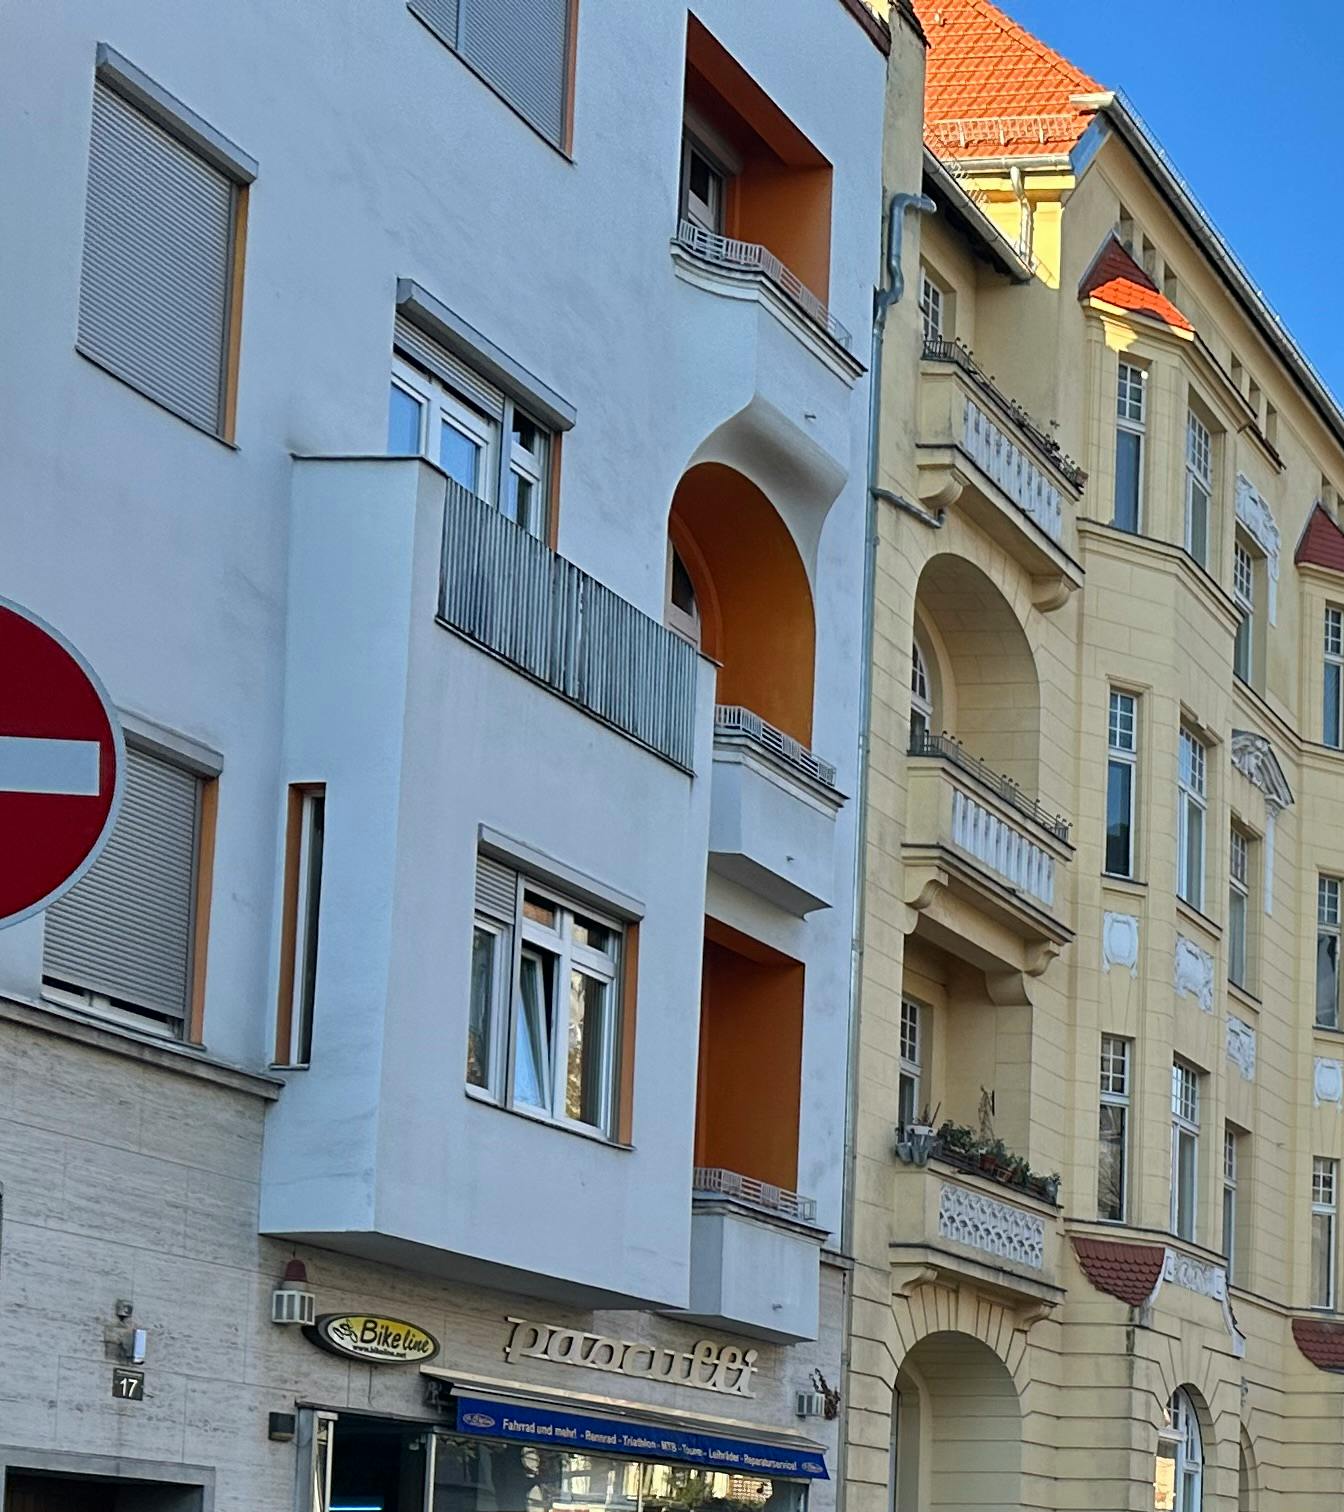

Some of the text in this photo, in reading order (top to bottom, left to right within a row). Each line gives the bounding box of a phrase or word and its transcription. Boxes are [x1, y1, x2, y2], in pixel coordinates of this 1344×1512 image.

[119, 1377, 138, 1398] 17
[503, 1418, 536, 1433] Fahrrad
[536, 1424, 553, 1436] und
